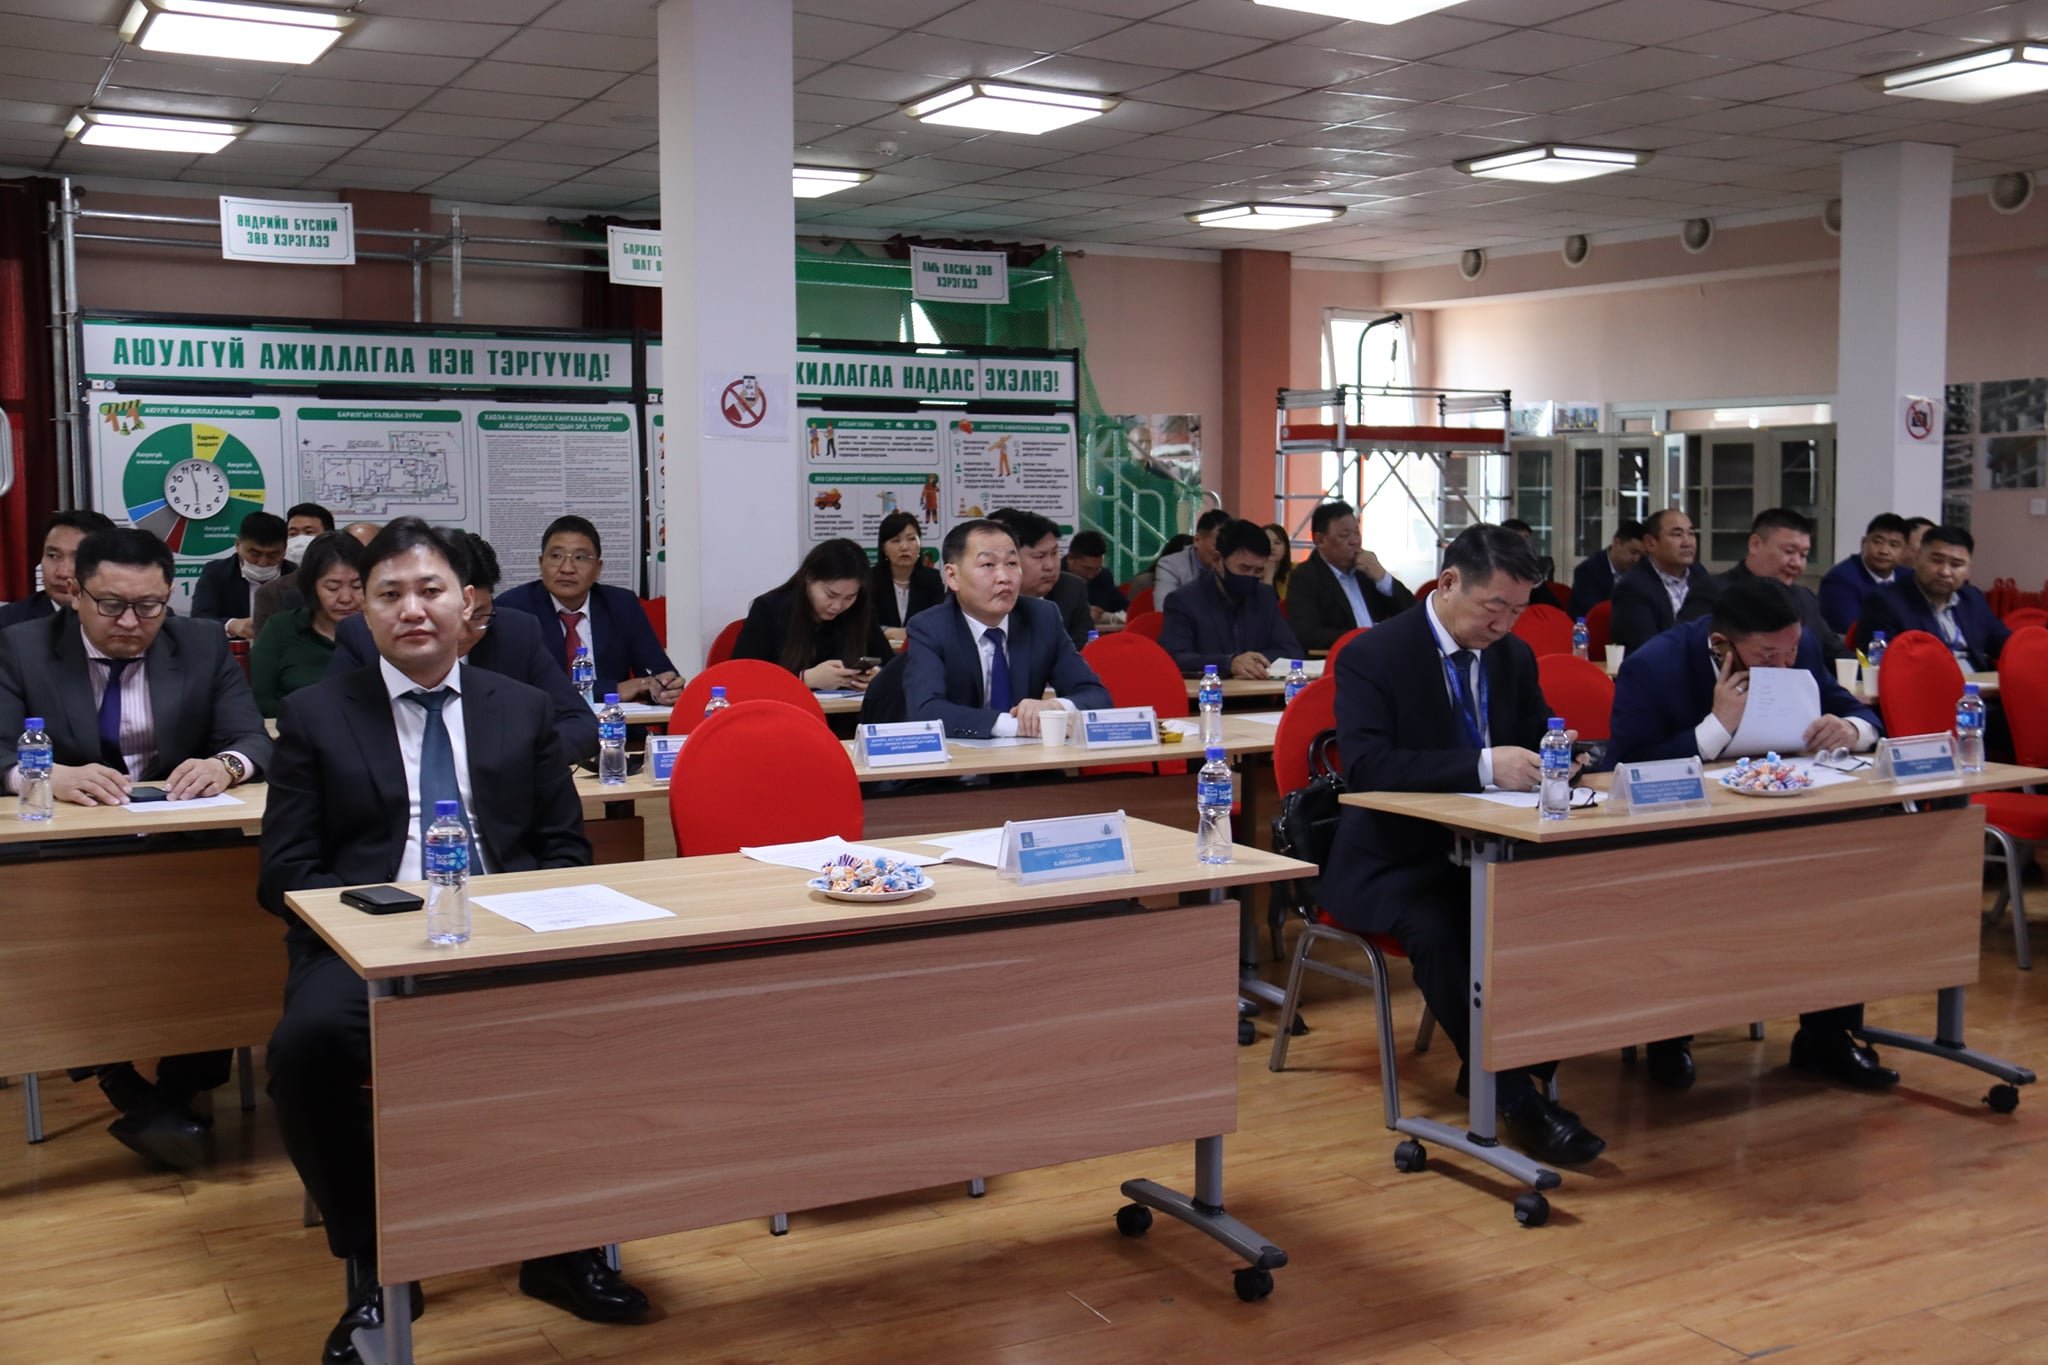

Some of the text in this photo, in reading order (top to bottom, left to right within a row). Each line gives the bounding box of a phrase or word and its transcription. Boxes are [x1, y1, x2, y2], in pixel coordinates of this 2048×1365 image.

[237, 214, 338, 232] ӨНДРИЙН БҮСНИЙ
[247, 231, 330, 248] ЗӨВ ХЭРЭГЛЭЭ
[632, 258, 651, 271] ШАТ
[937, 276, 978, 289] ХЭРЭГЛЭЭ
[113, 336, 610, 382] АЮУЛГҮЙ АЖИЛЛАГАА НЭН ТЭРГҮҮНД!
[903, 365, 975, 393] НАДААС
[985, 367, 1060, 392] ЭХЭЛНЭ!
[144, 406, 179, 415] АЮУЛГҮЙ
[180, 407, 234, 416] АЖИЛЛАГААНЫ
[191, 464, 202, 472] 12
[173, 475, 183, 483] 10
